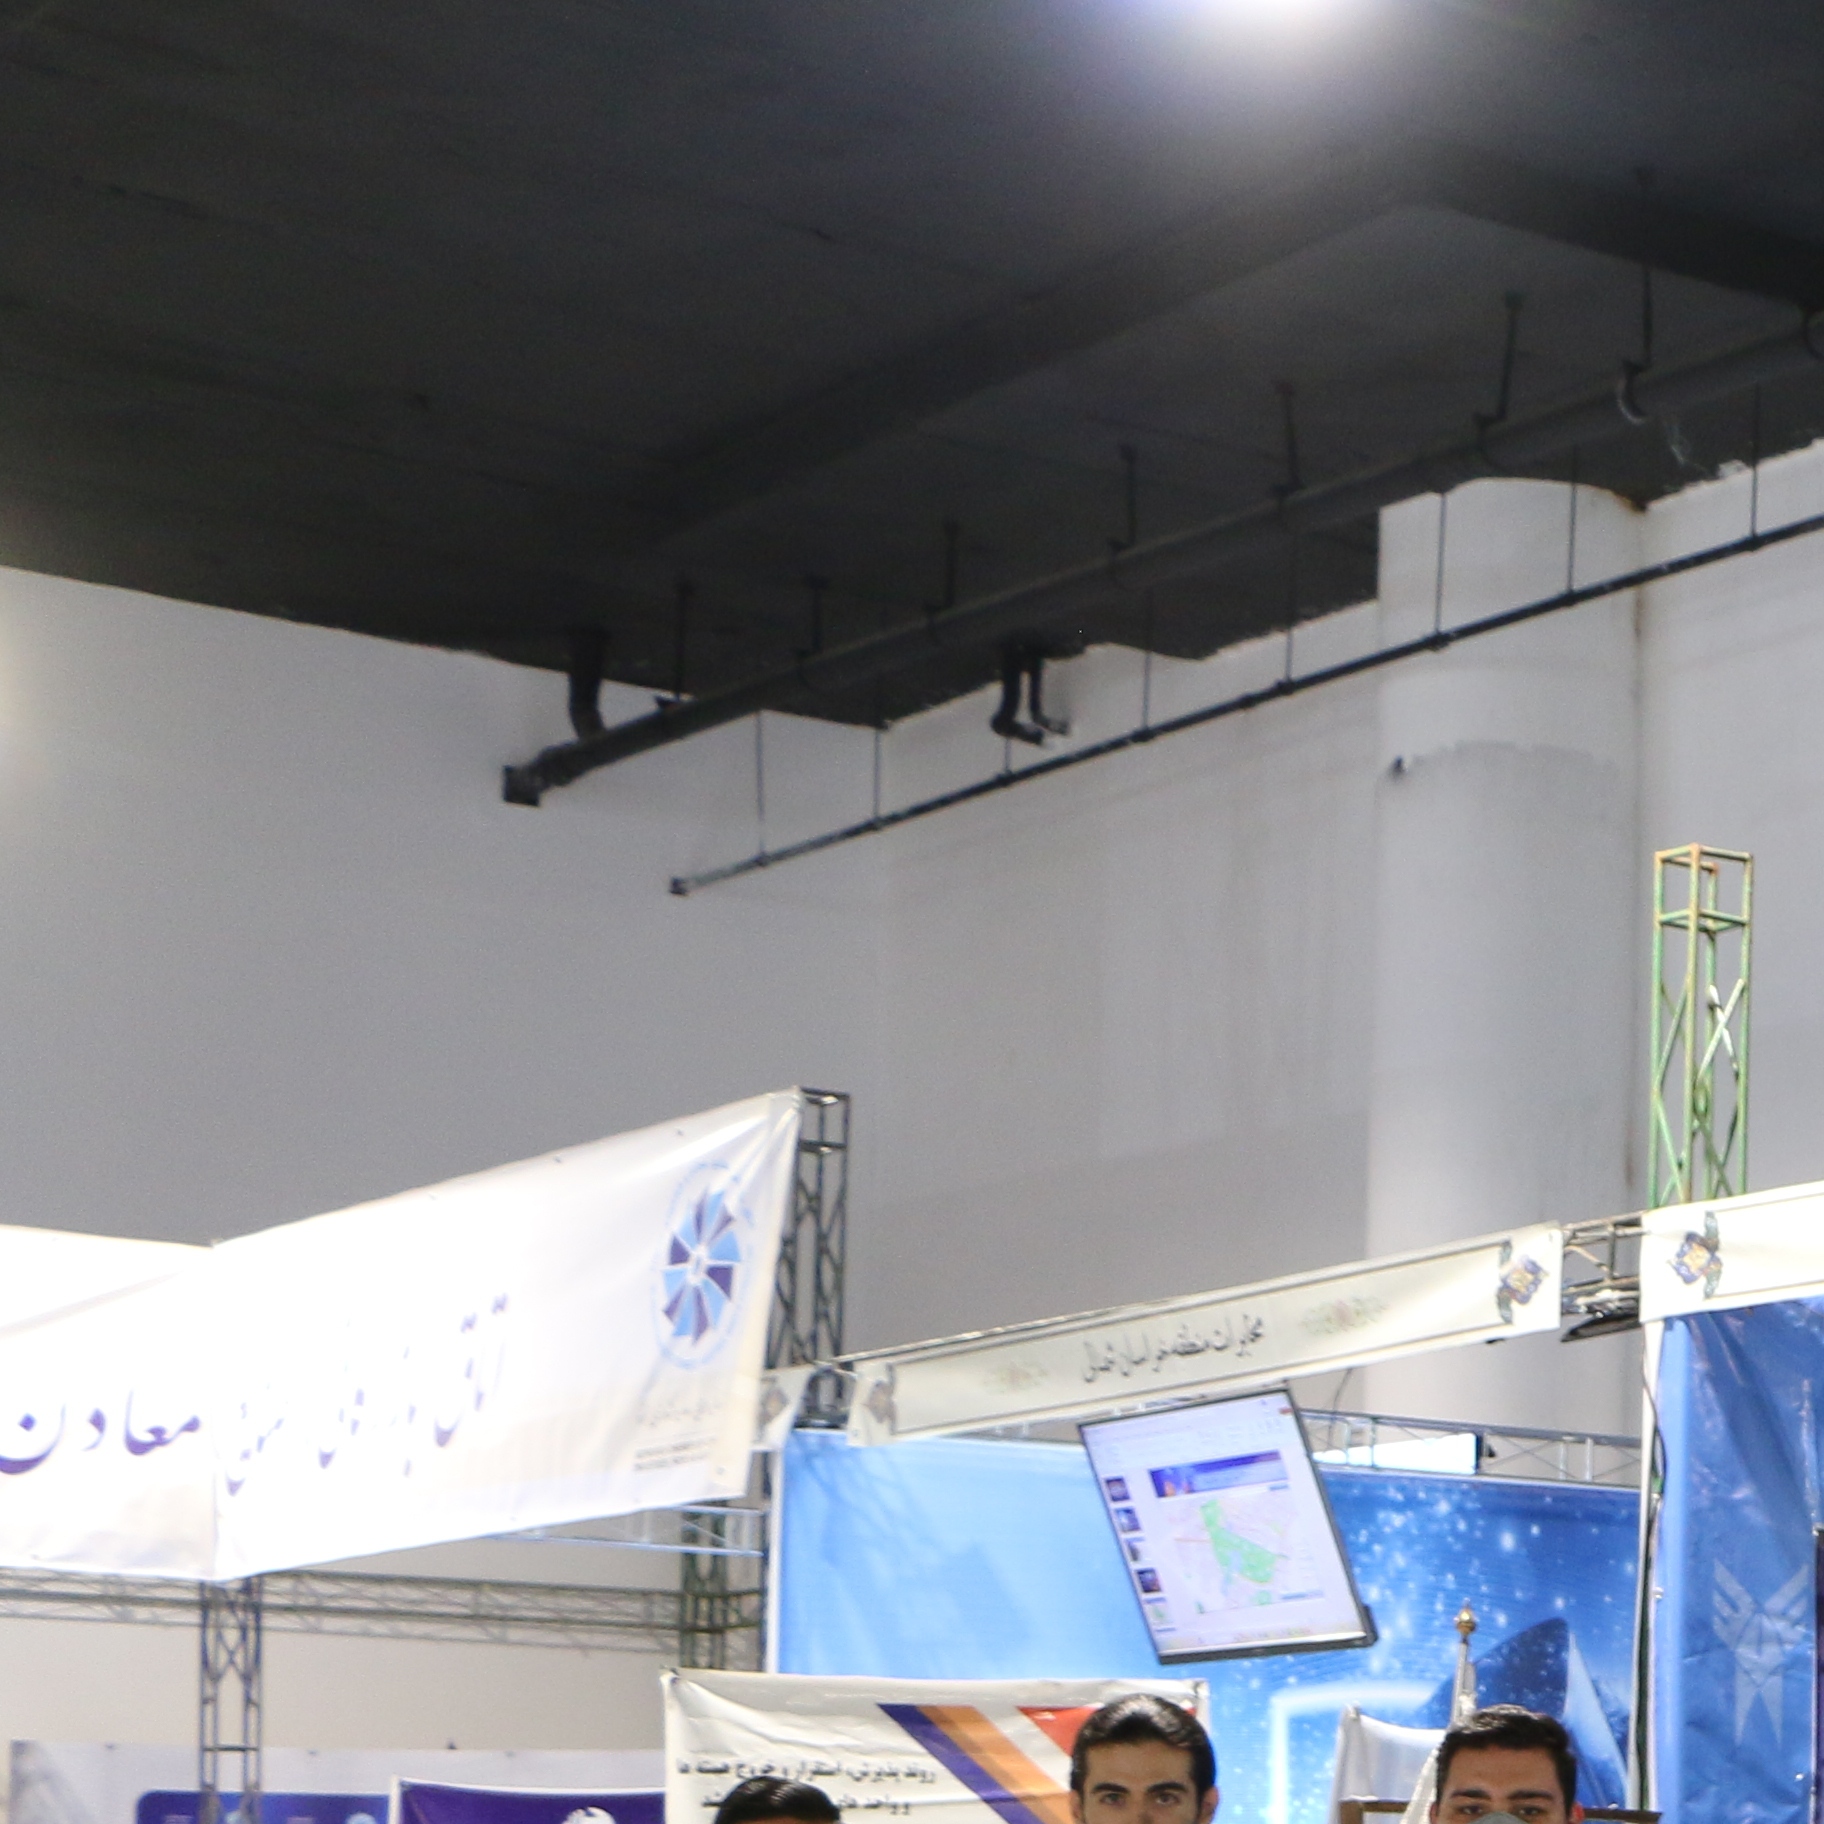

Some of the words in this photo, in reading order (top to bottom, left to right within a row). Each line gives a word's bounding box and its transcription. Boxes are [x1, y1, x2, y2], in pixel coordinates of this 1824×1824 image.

[1117, 1331, 1168, 1377] خراسان
[1212, 1313, 1263, 1357] مخابرات
[1081, 1340, 1117, 1384] شمالی
[0, 1387, 201, 1475] معادن
[904, 1760, 937, 1783] روند
